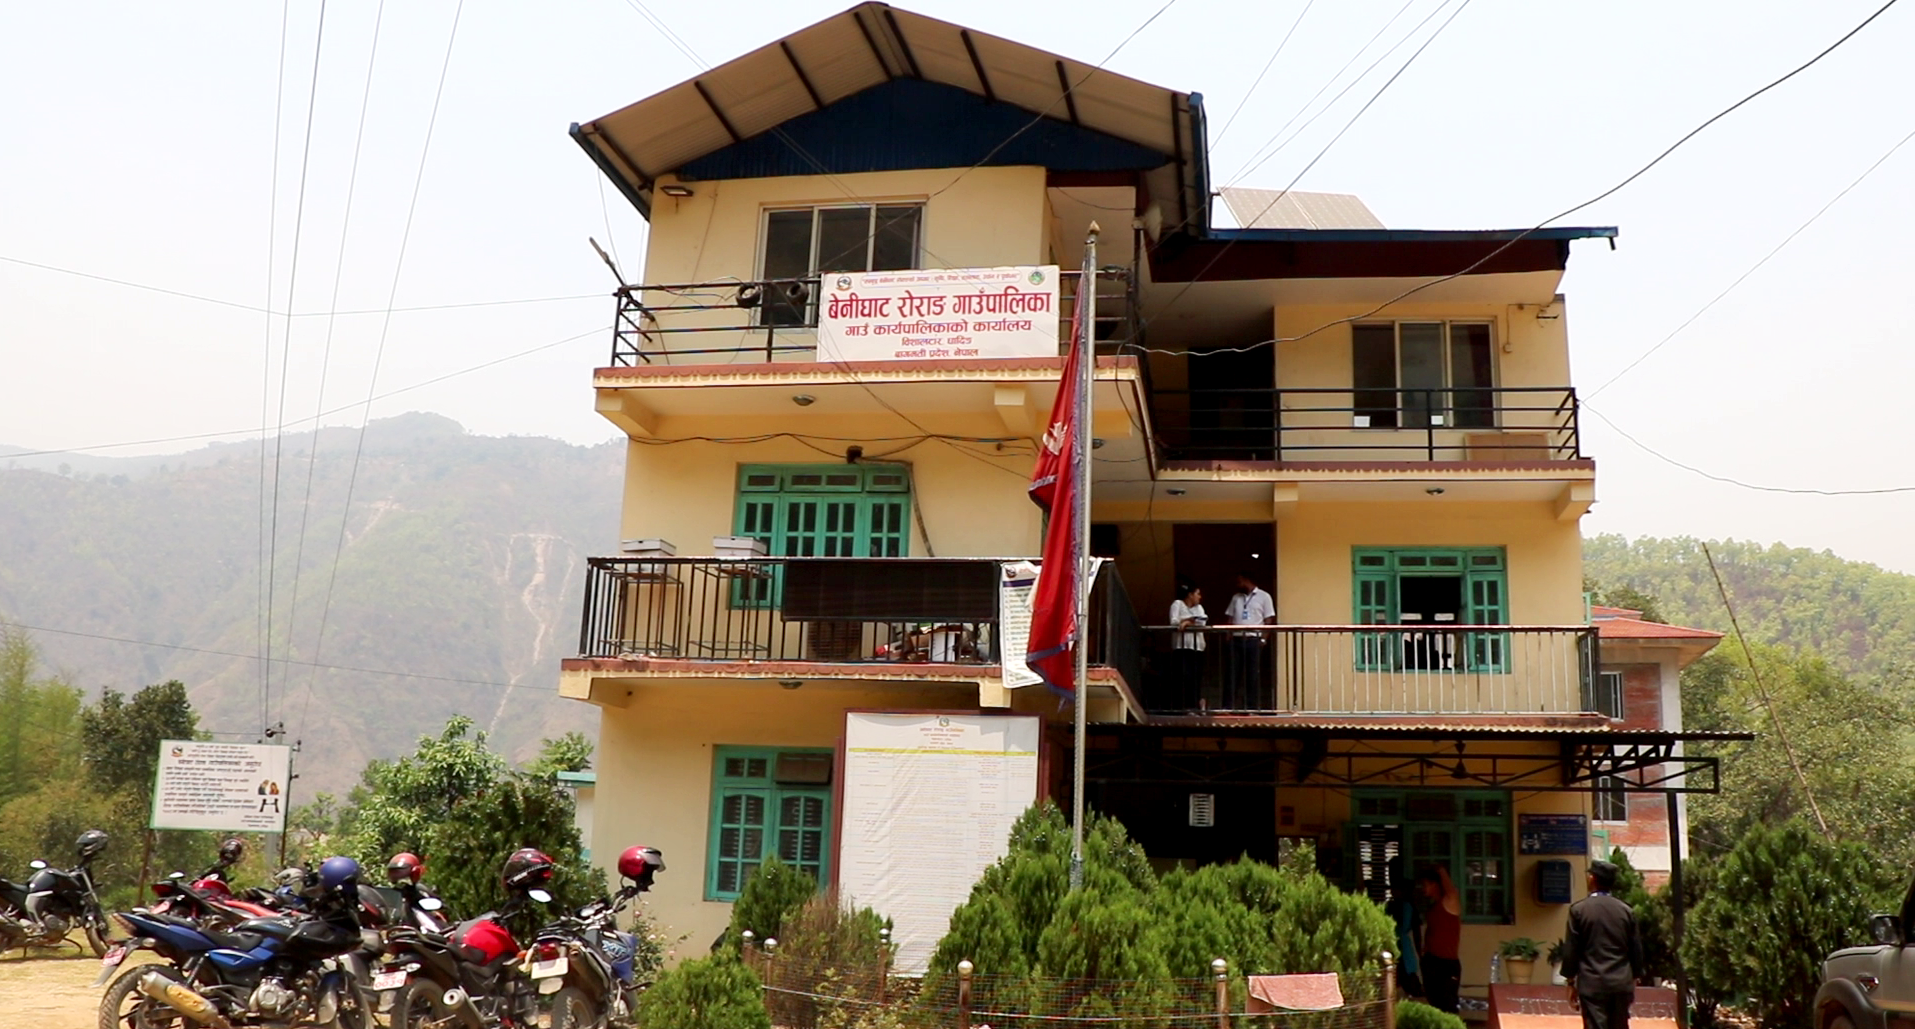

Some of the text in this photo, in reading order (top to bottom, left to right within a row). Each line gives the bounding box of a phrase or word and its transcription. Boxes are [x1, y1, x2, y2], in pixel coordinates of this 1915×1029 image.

[828, 285, 1052, 319] बेनीघाट रोराङ गाउँपालिका
[873, 318, 969, 335] कार्यपालिकाको
[972, 317, 1032, 332] कार्यालय
[954, 347, 978, 357] नेपाल
